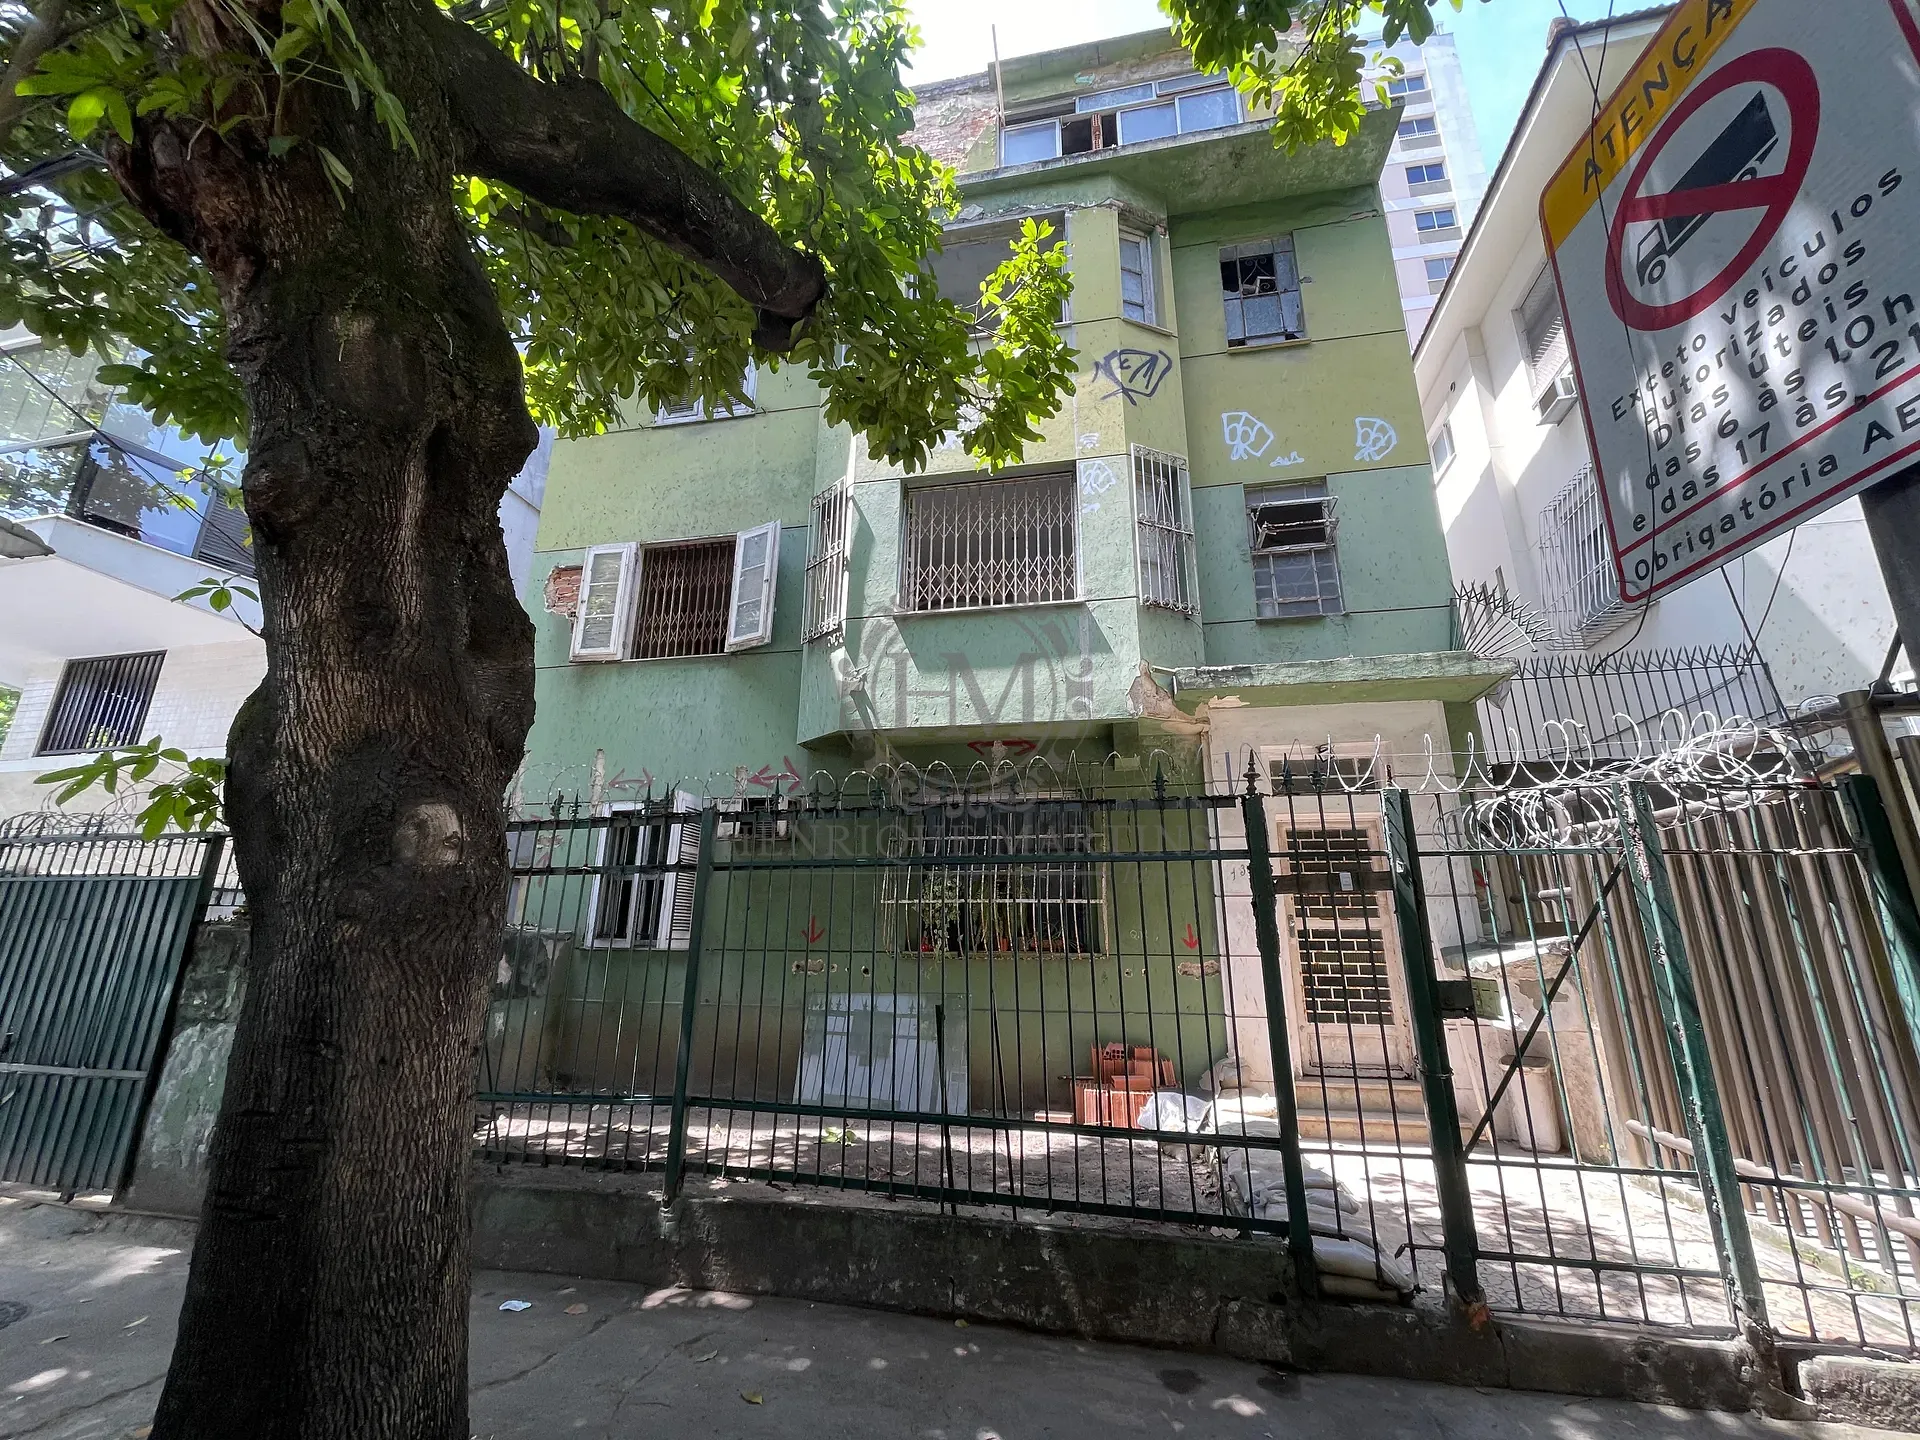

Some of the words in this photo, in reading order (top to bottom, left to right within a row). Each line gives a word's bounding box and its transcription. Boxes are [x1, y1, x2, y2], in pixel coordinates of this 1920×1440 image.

[1611, 333, 1706, 422] Exceto
[1721, 167, 1903, 325] veículos
[1645, 239, 1866, 425] autorizados
[1652, 383, 1730, 451] Dias
[1748, 280, 1869, 379] úteis
[1632, 513, 1646, 532] e
[1661, 464, 1721, 515] das
[1735, 421, 1771, 466] 17
[1795, 381, 1848, 428] às
[1645, 440, 1702, 490] das
[1717, 409, 1739, 439] 6
[1758, 367, 1805, 413] às
[1634, 453, 1839, 581] Obrigatória
